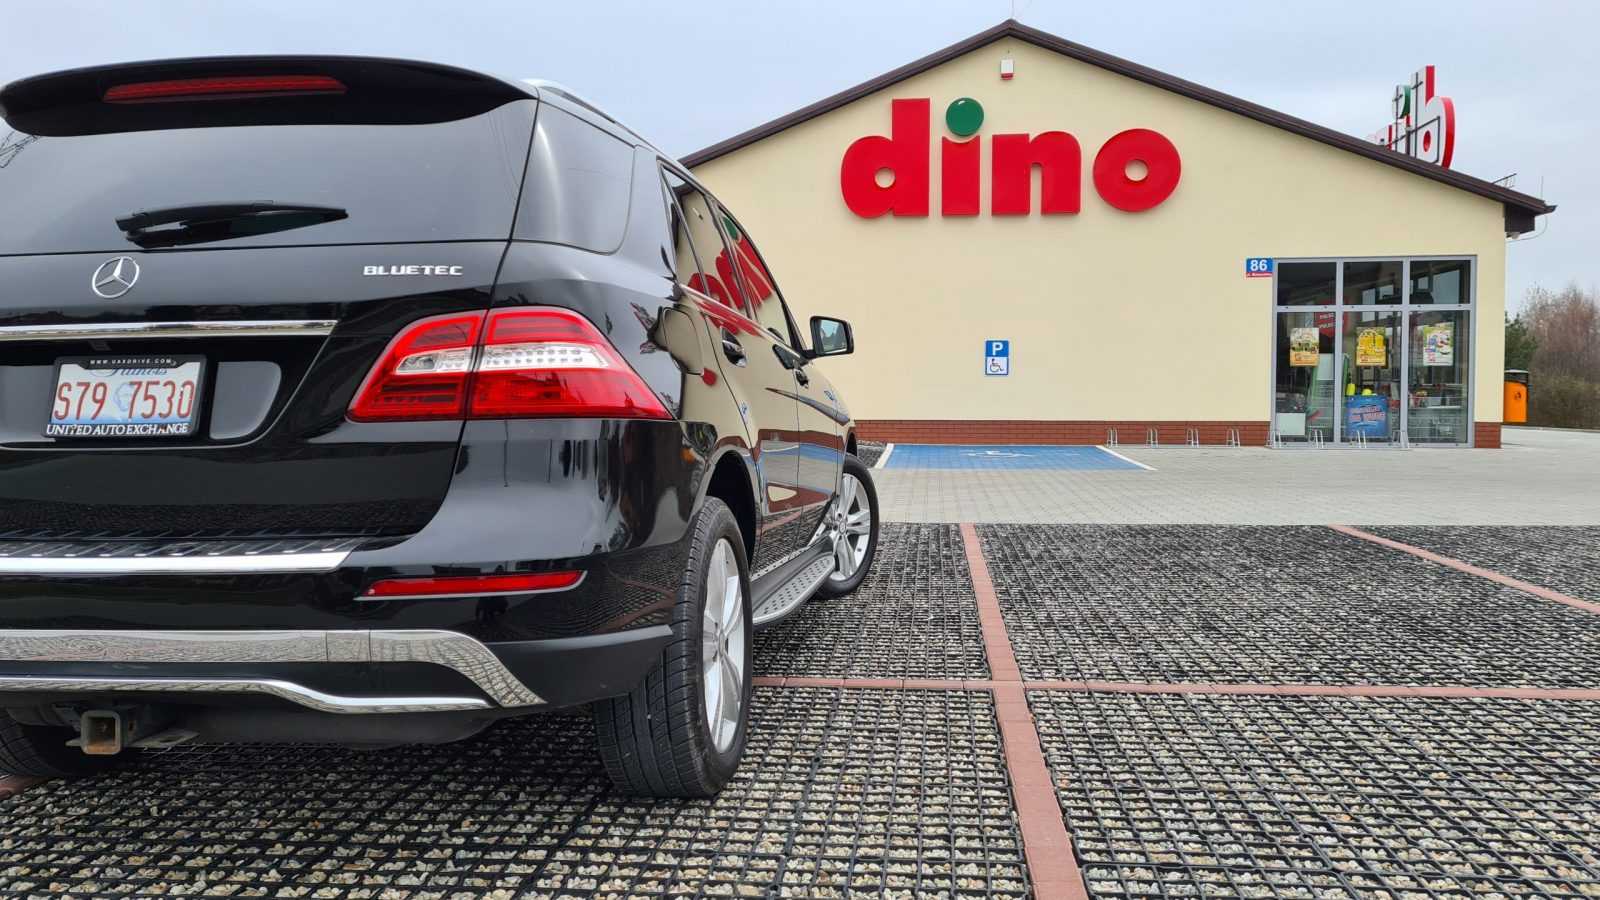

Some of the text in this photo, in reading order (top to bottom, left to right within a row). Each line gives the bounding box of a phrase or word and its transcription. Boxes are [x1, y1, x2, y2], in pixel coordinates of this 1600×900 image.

[841, 97, 1181, 218] dino
[363, 265, 463, 276] BLUETEC
[1250, 259, 1268, 271] 86
[992, 342, 1004, 356] P
[54, 380, 195, 420] S79 7530
[46, 423, 189, 435] UNITED AUTO EXCHANGE
